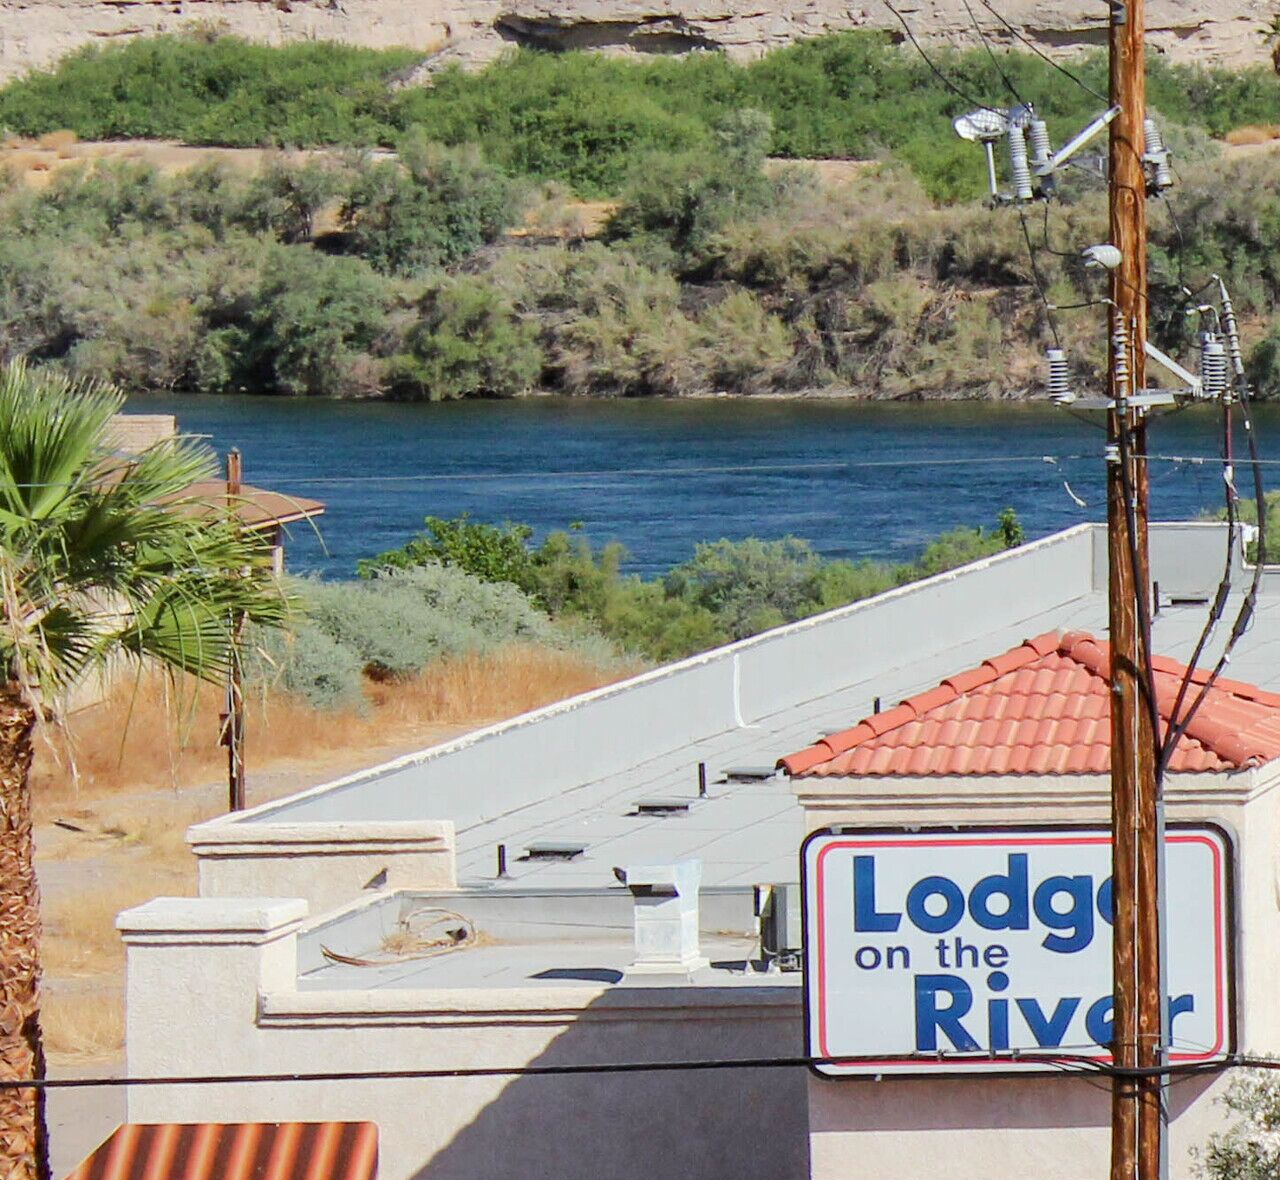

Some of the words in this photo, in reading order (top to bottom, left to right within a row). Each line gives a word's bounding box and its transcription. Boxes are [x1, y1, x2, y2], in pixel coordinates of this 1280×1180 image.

[853, 853, 1114, 953] Lodg
[854, 944, 910, 970] on
[936, 937, 1009, 969] the
